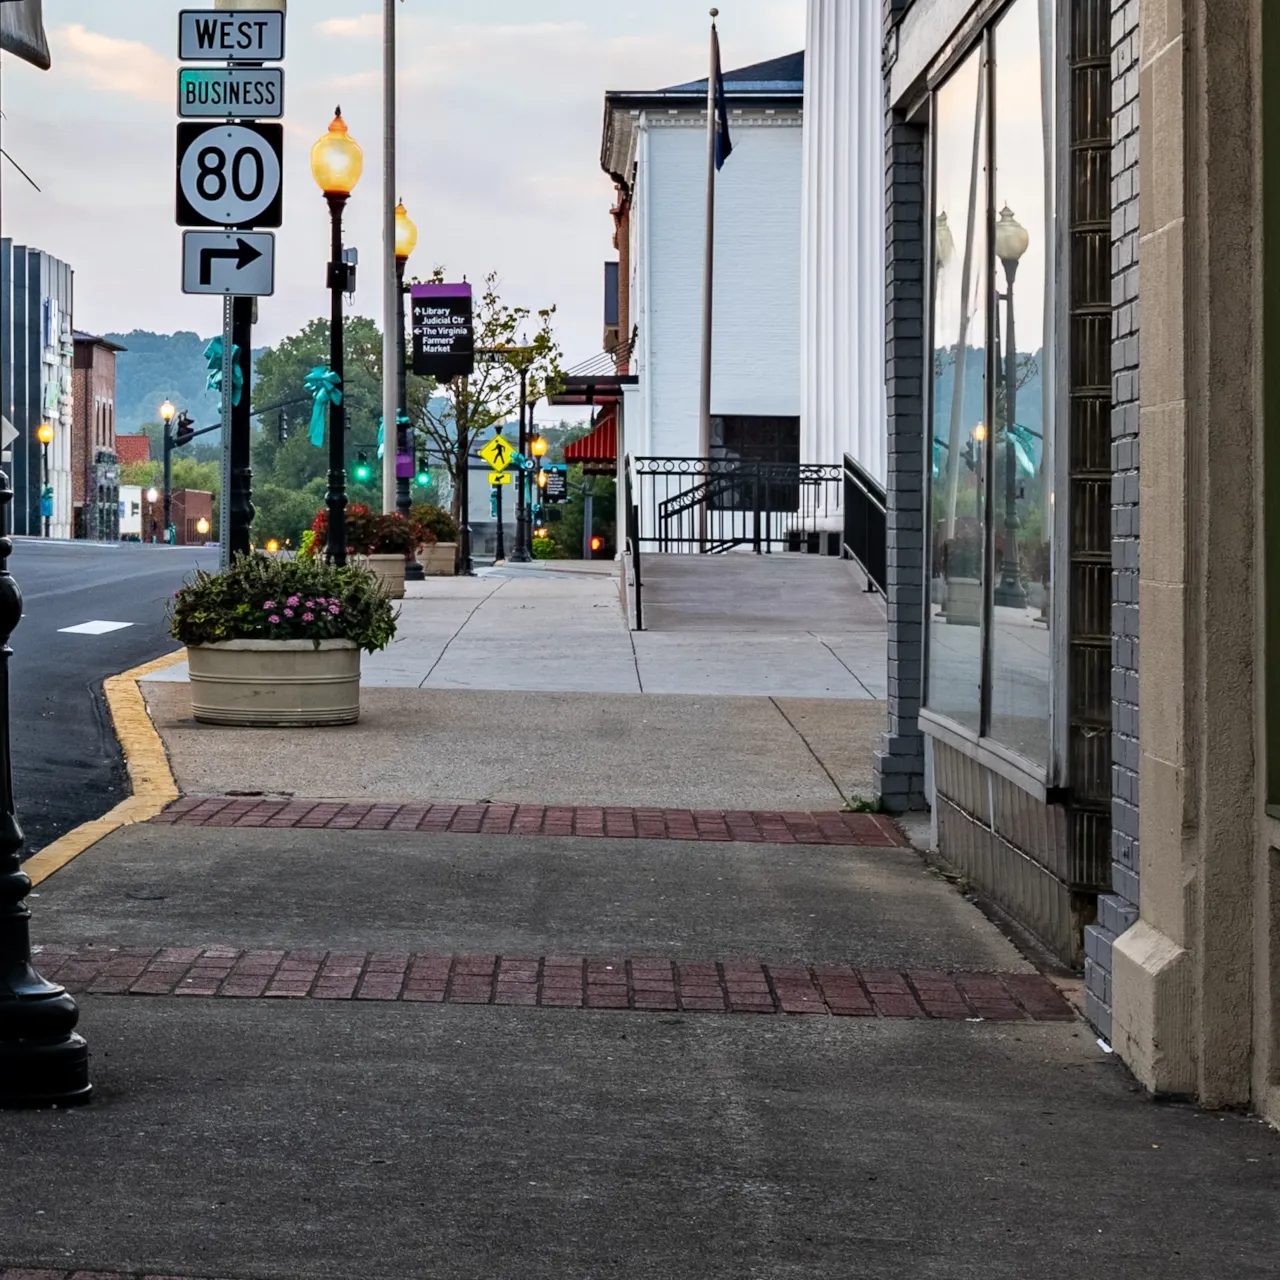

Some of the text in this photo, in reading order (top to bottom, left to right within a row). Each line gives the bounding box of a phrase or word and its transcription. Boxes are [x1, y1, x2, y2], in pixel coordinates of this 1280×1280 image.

[195, 18, 268, 50] WEST
[185, 81, 276, 105] BUSINESS
[196, 146, 264, 201] 80
[422, 307, 450, 316] Library
[422, 316, 465, 325] Judicial Ctr
[422, 327, 468, 336] The Virginia
[422, 345, 451, 353] Market
